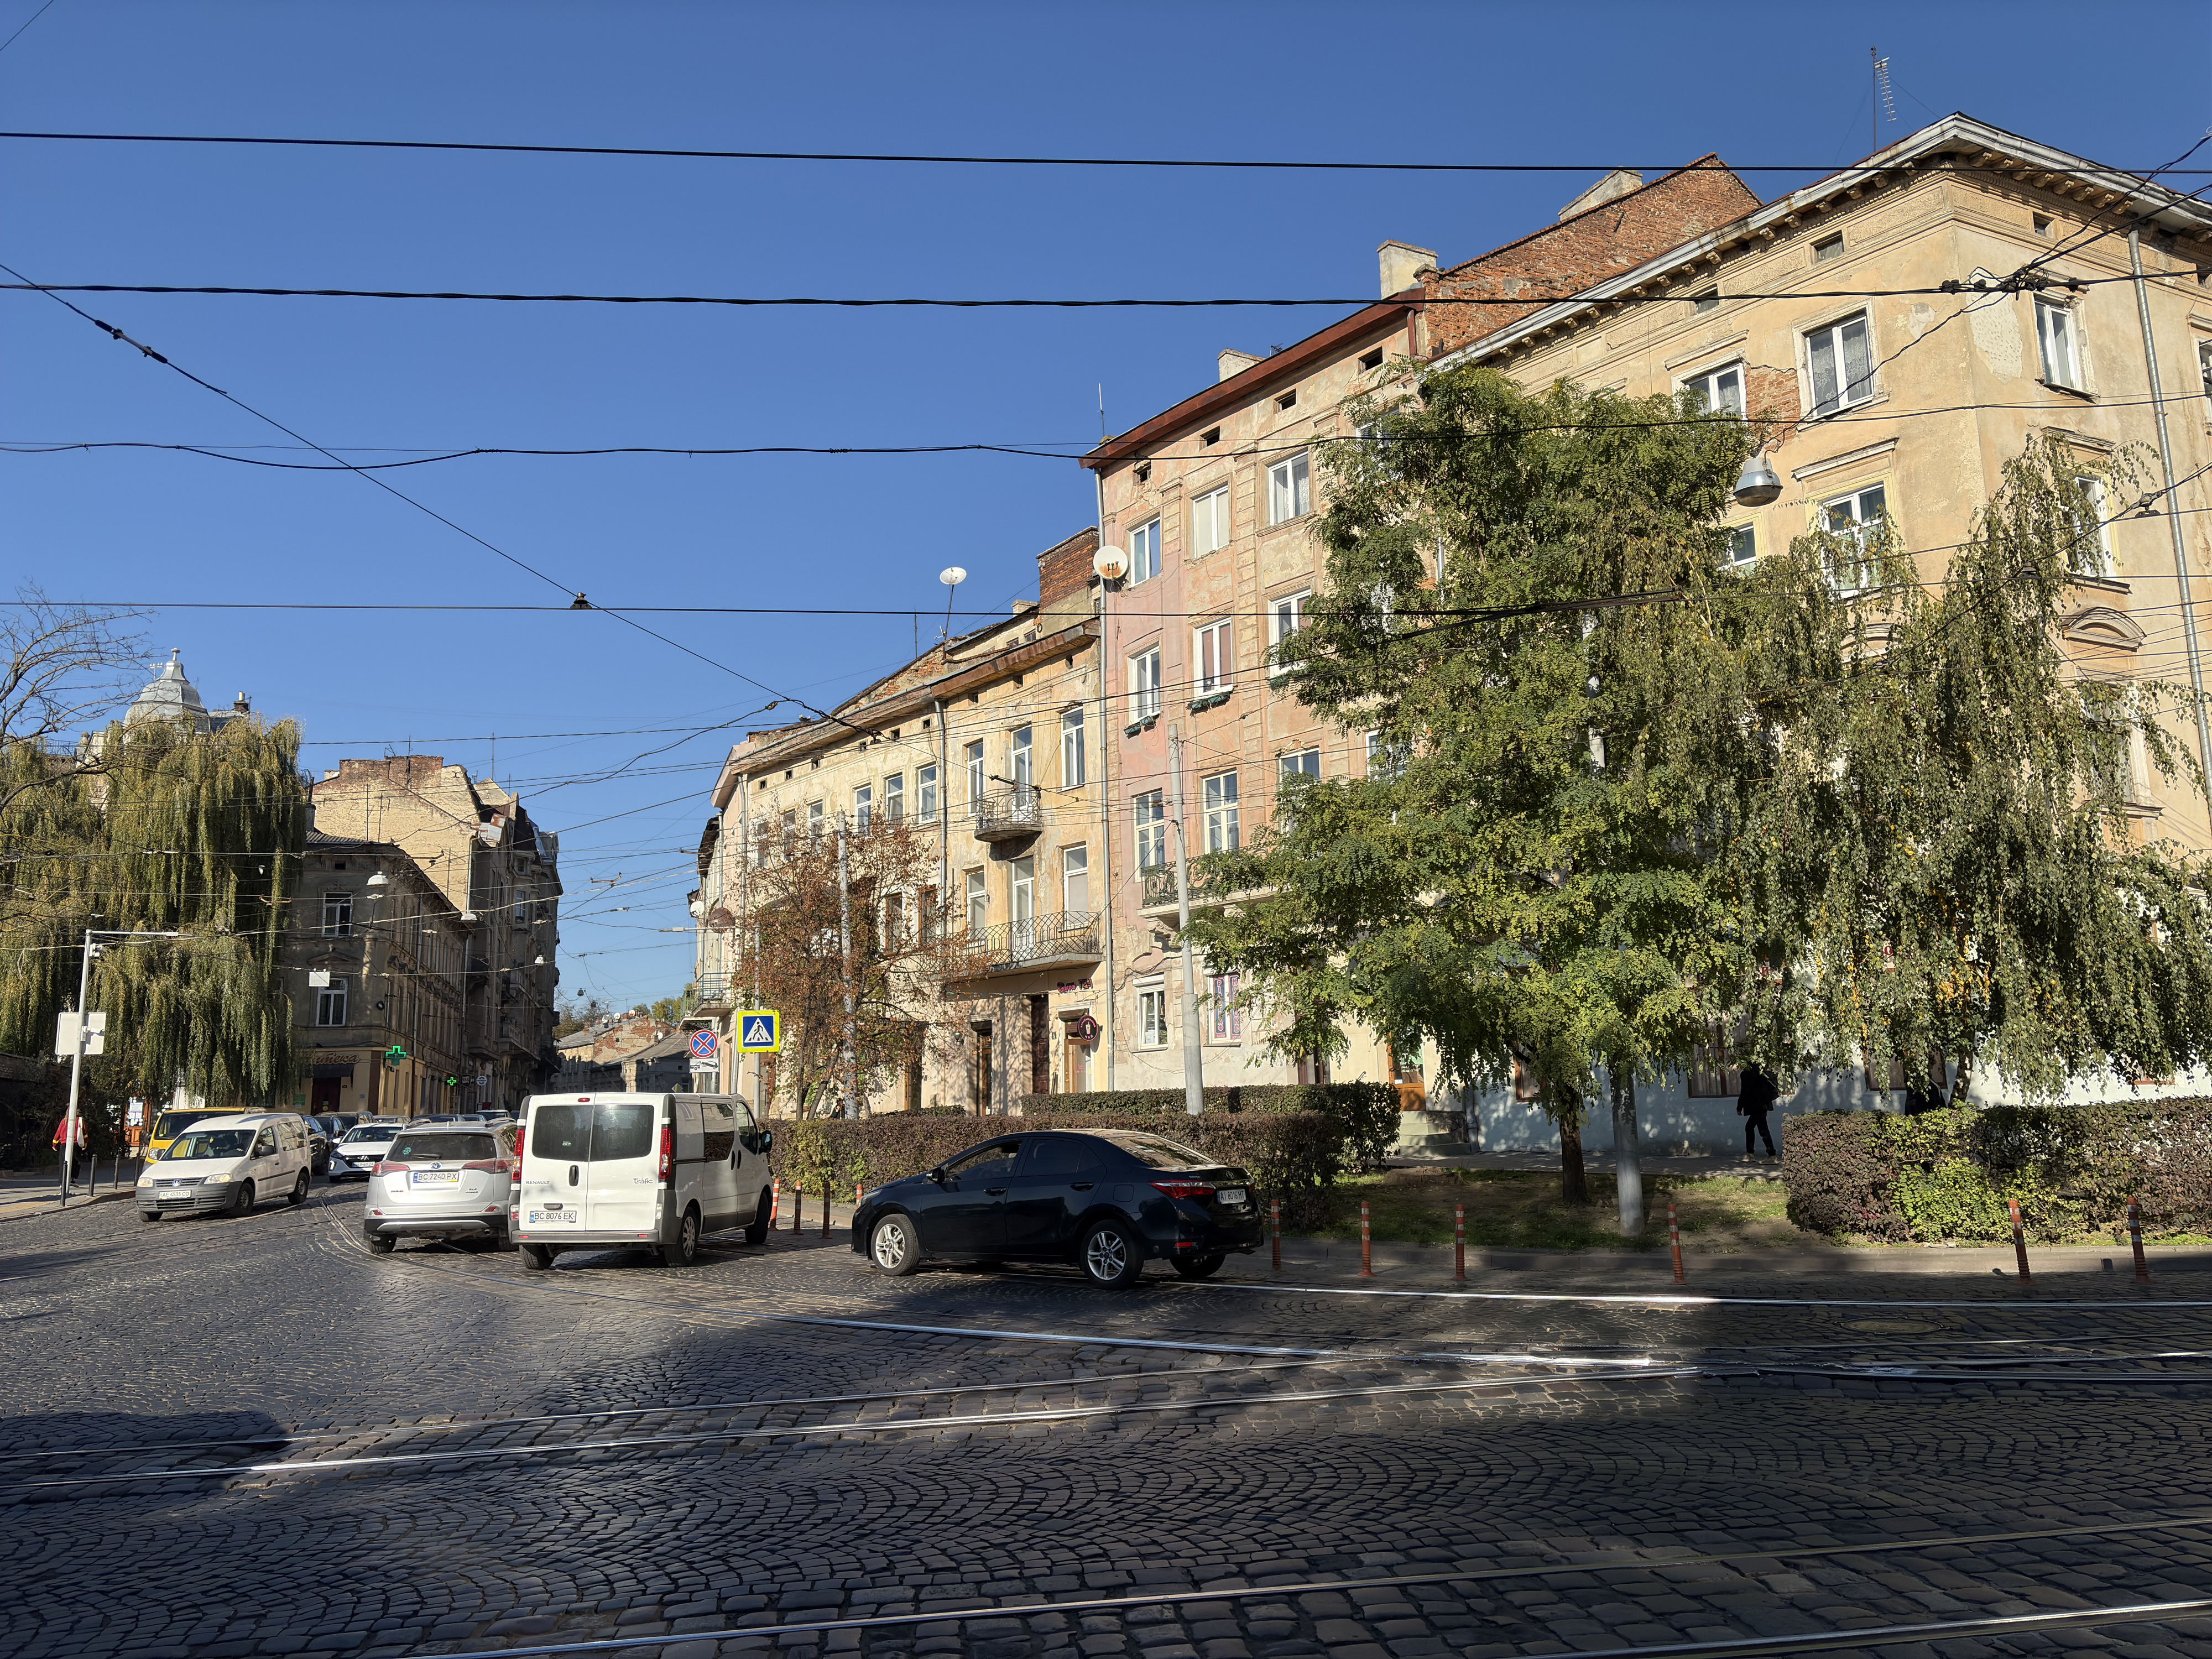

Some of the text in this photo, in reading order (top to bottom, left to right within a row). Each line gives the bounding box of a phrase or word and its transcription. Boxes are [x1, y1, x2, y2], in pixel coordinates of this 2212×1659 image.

[1078, 978, 1093, 990] TEA
[308, 1052, 359, 1064] птека
[1220, 1190, 1244, 1201] AI 8016 MT
